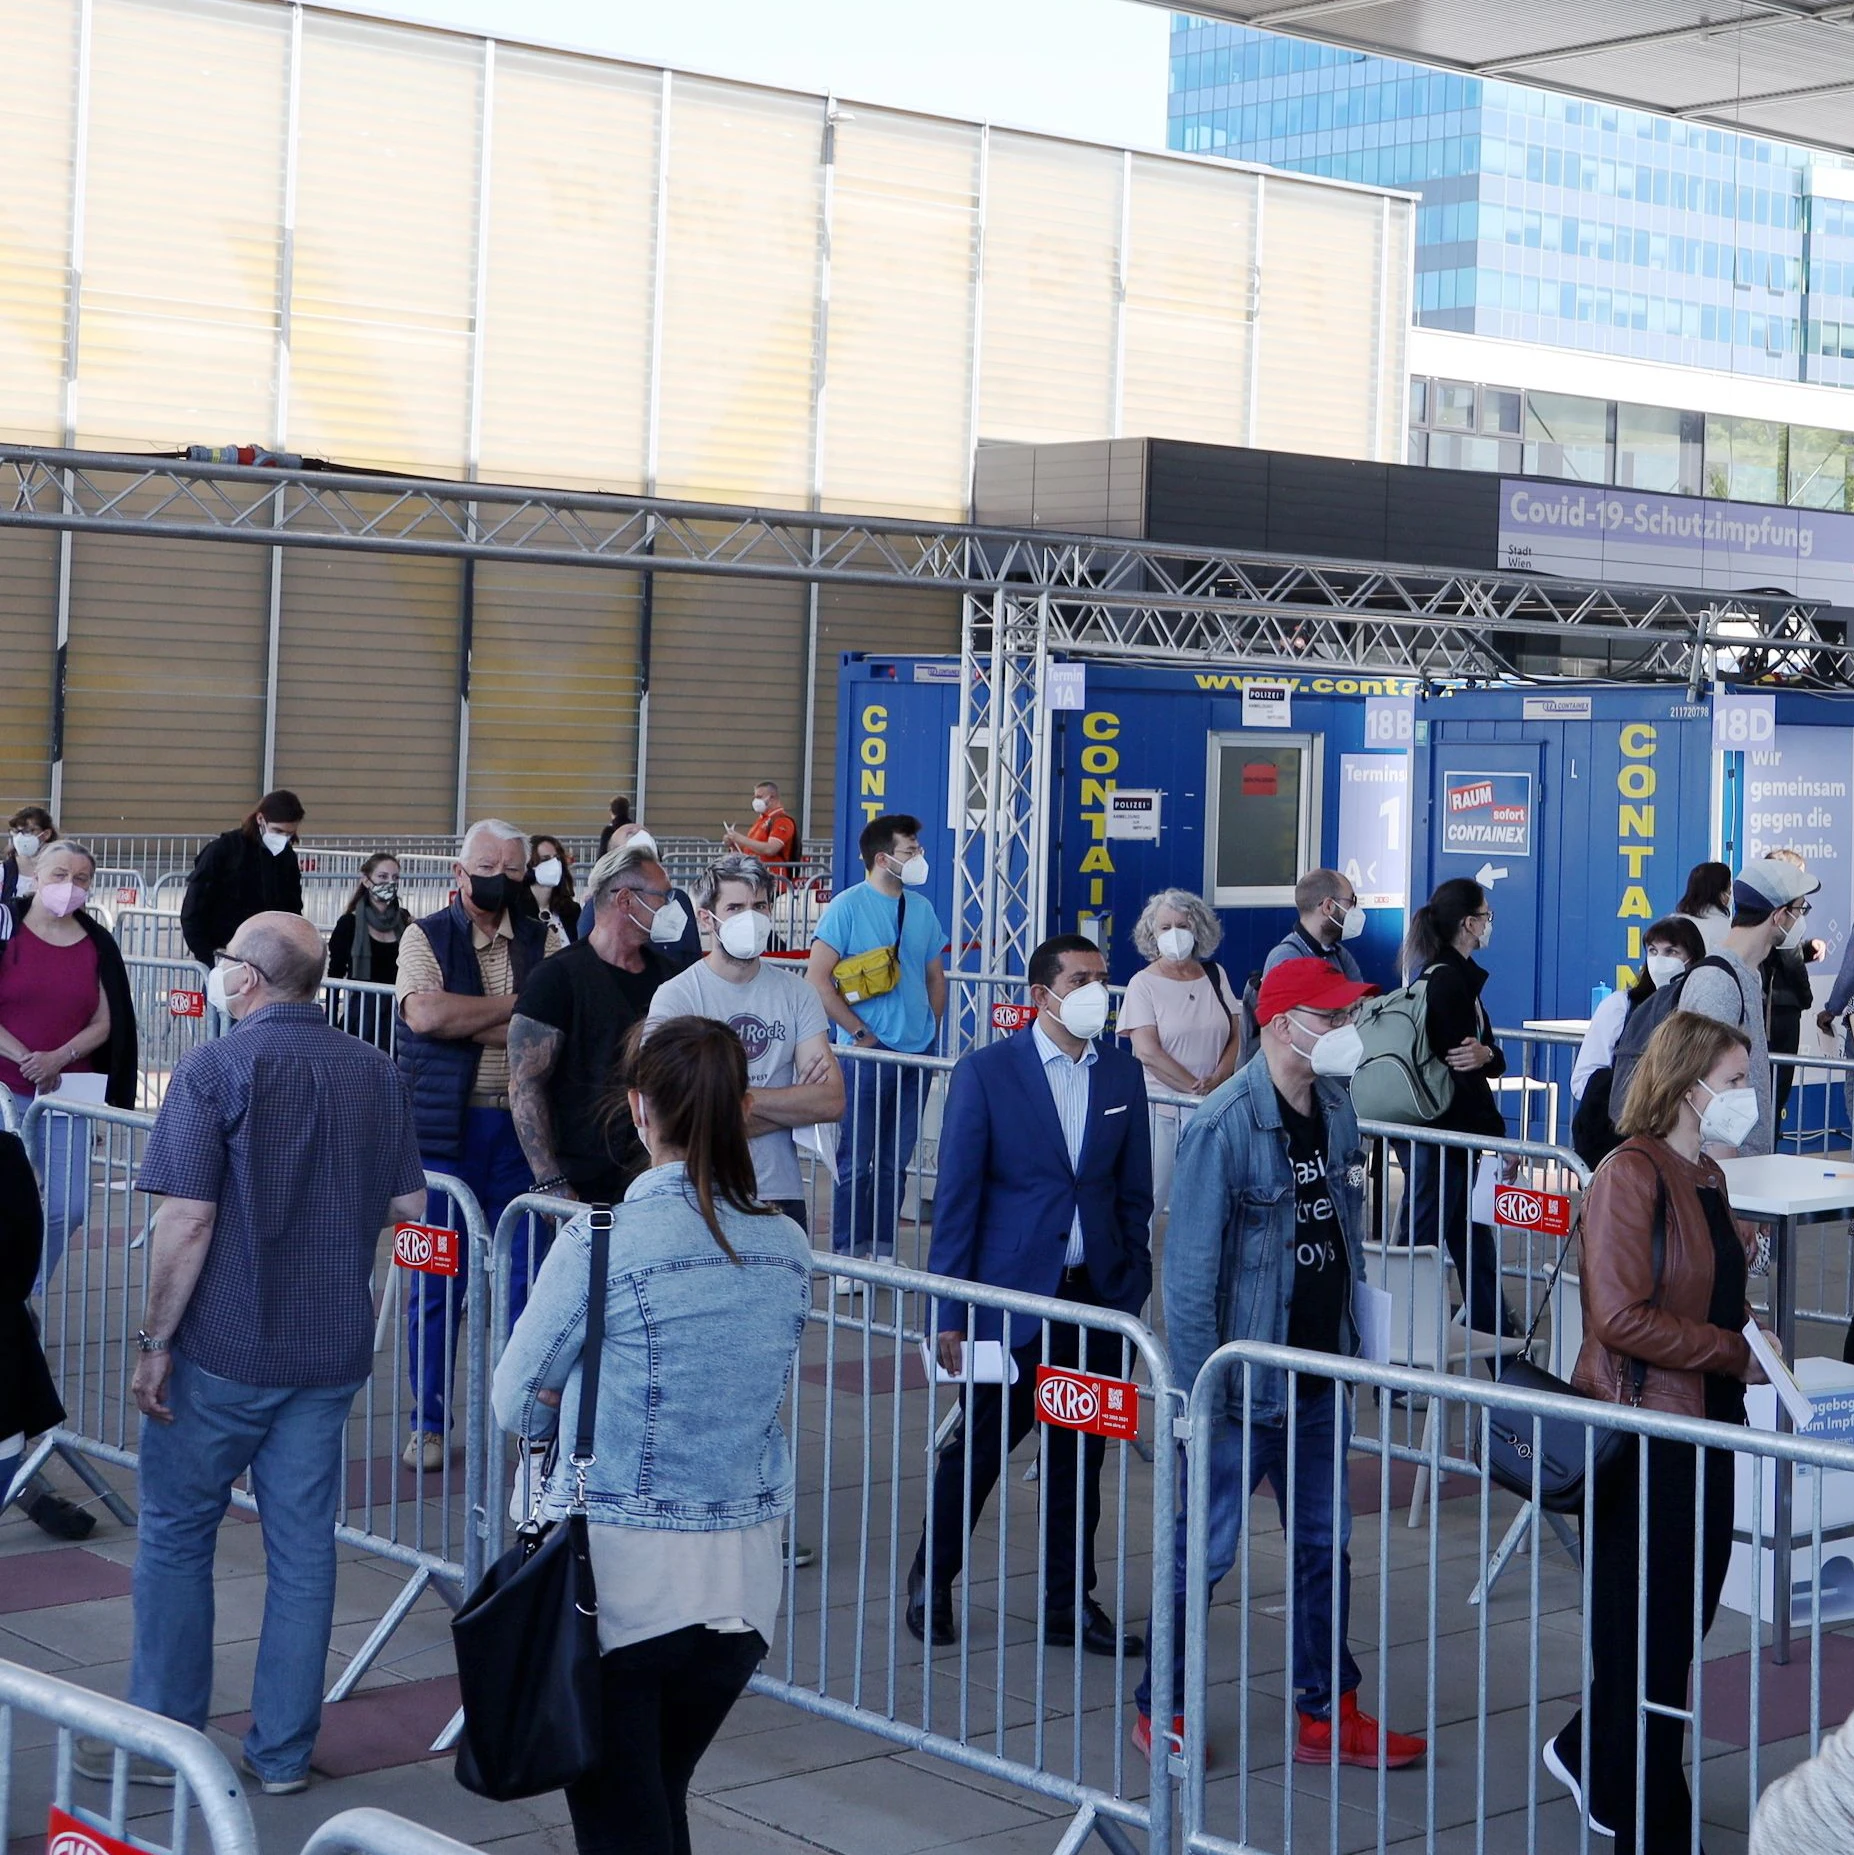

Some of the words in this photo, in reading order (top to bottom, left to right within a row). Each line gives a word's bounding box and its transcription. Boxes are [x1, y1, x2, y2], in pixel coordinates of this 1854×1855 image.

[1510, 490, 1813, 556] Covid-19-Schutzimpfung
[1508, 544, 1532, 557] Stadt
[1508, 557, 1532, 568] Wien
[1046, 667, 1083, 683] Termin
[1055, 685, 1075, 706] 1A
[1250, 690, 1280, 700] POLIZEI
[1670, 706, 1709, 718] 211720798
[1367, 709, 1412, 740] 18B
[1714, 708, 1773, 742] 18D
[1752, 750, 1782, 767] Wir
[1345, 764, 1408, 782] Termins
[1451, 785, 1493, 811] RAUM
[1751, 776, 1846, 802] gemeinsam
[1114, 801, 1146, 809] POLIZEI
[1493, 807, 1525, 821] sofort
[1751, 811, 1803, 834] gegen
[1807, 807, 1832, 828] die
[1448, 824, 1525, 844] CONTAINEX
[171, 993, 189, 1011] EKRO
[993, 1008, 1018, 1025] EKRO
[746, 1020, 785, 1044] Rock
[1498, 1194, 1539, 1221] EKRO
[397, 1231, 429, 1262] EKRO
[1041, 1380, 1094, 1419] EKRO
